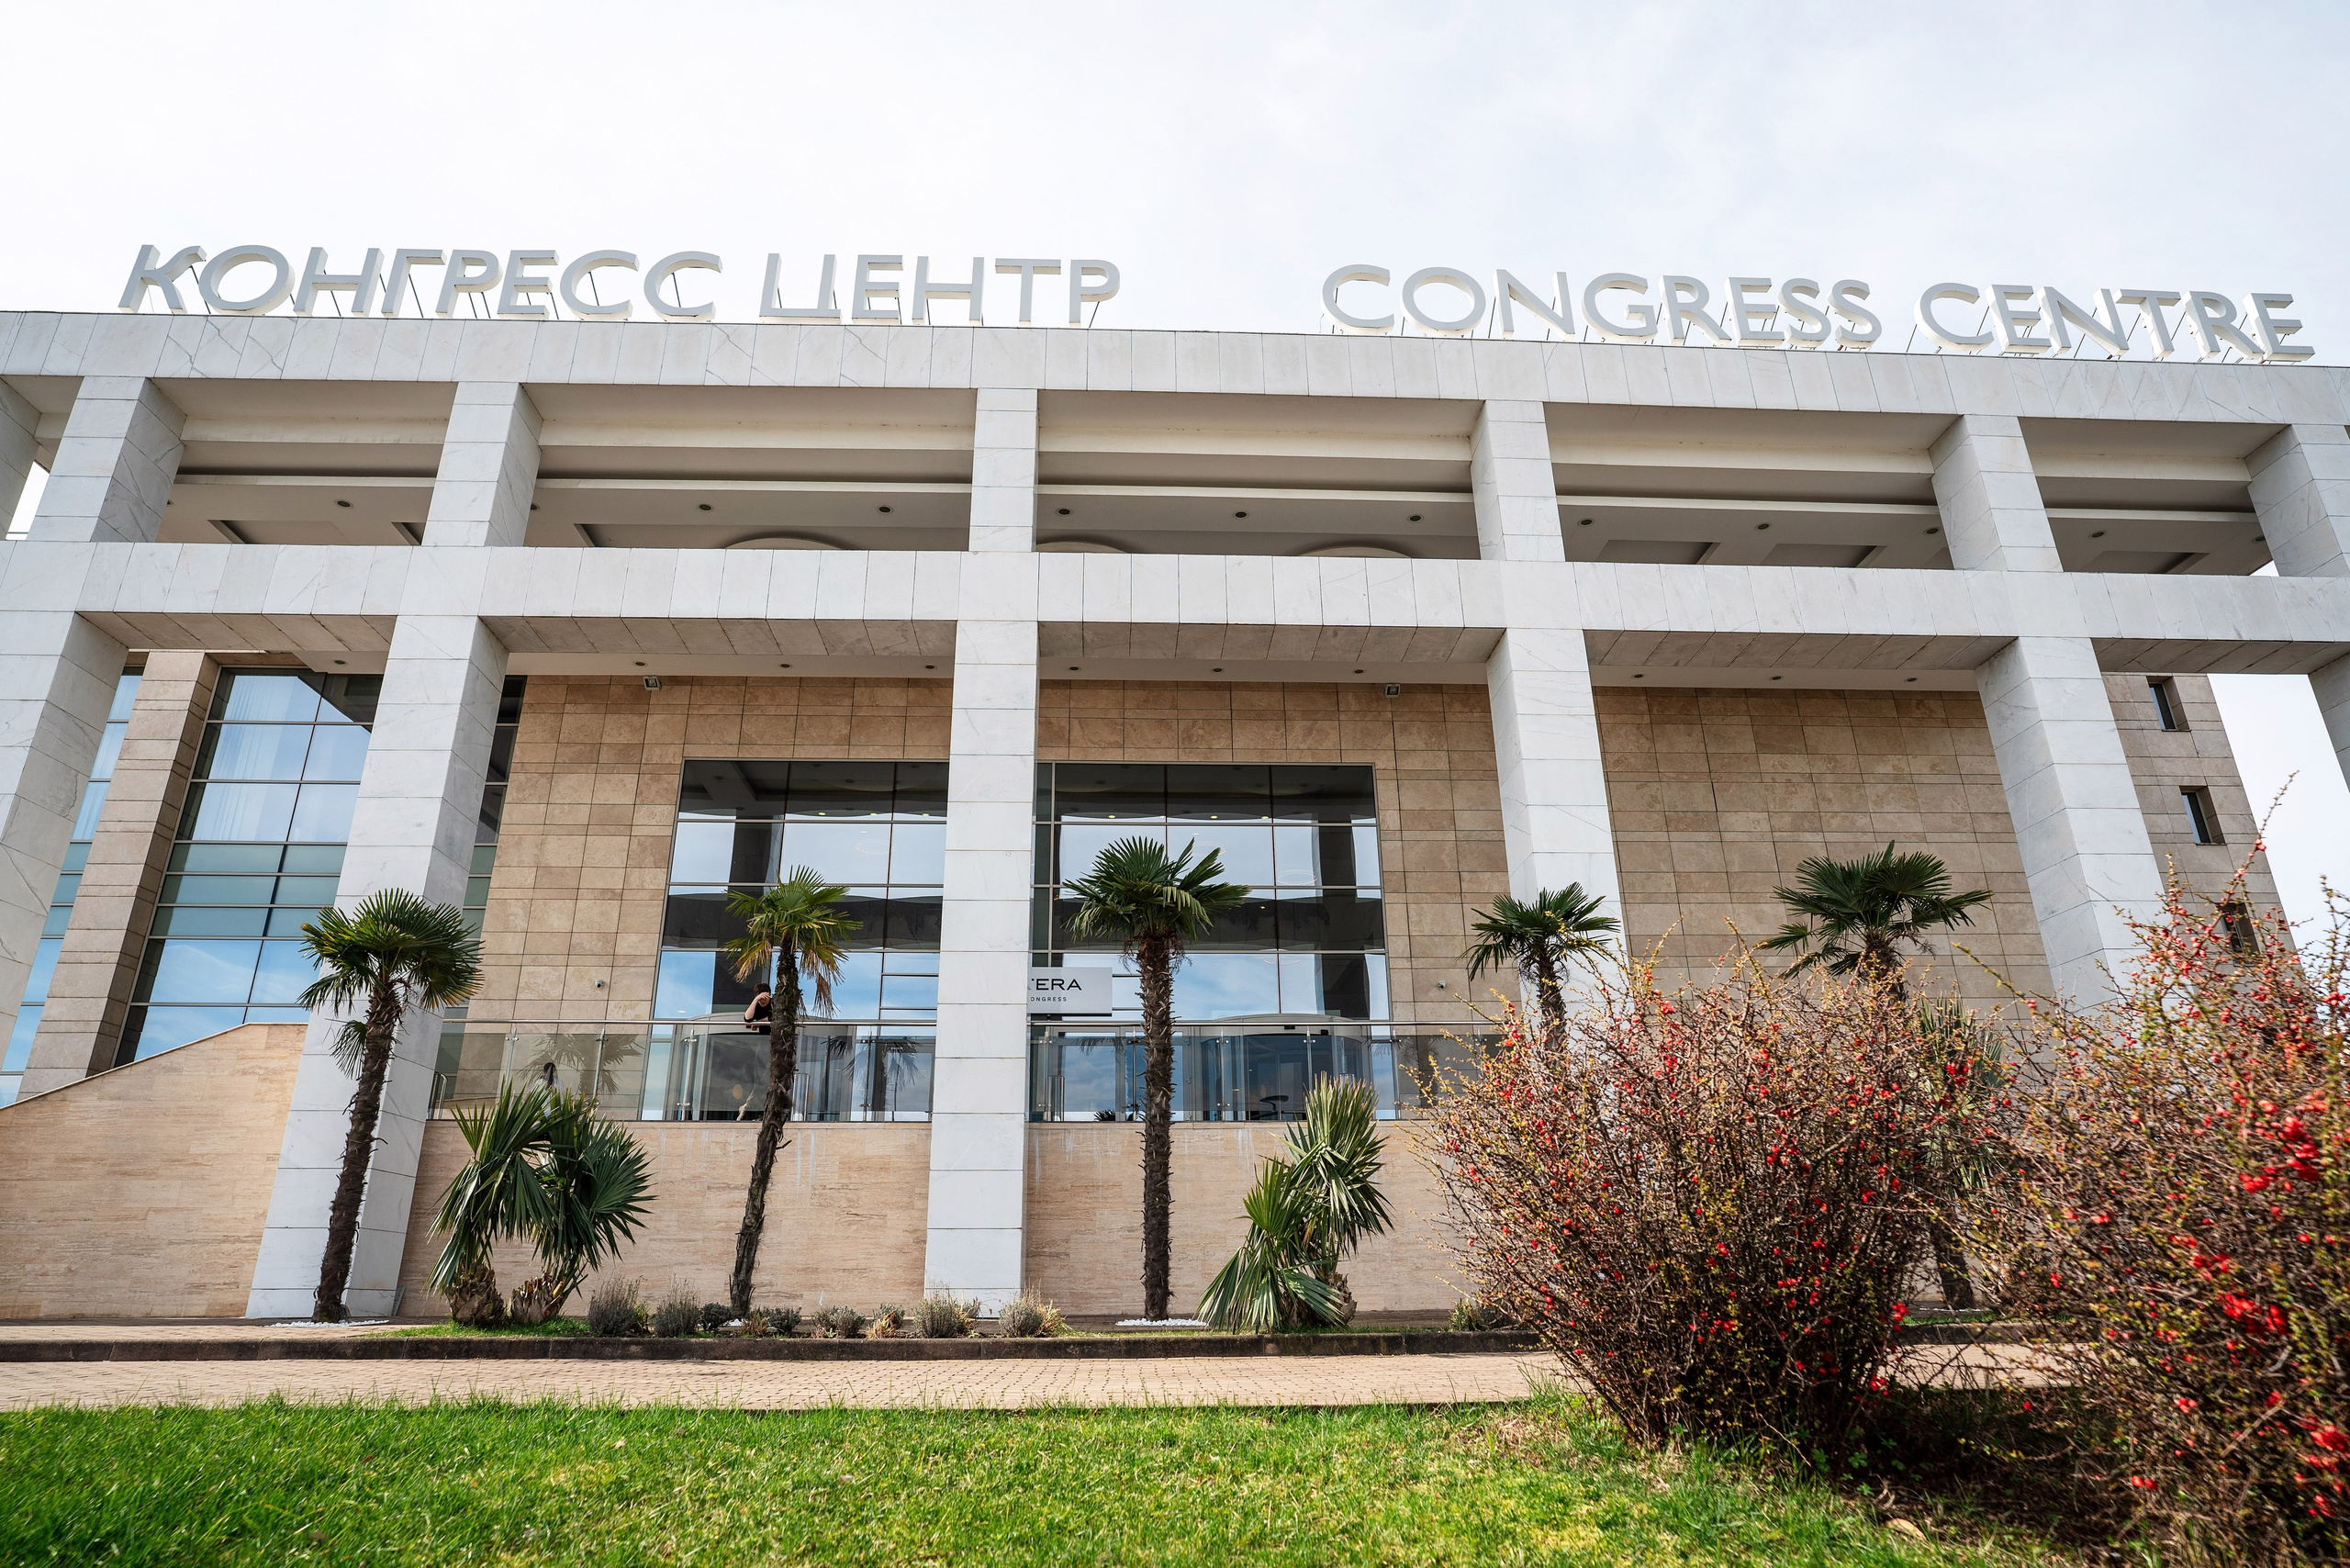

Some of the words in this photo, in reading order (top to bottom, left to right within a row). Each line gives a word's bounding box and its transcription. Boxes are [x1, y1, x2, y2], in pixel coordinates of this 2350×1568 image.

[118, 243, 722, 322] КОНГРЕСС
[759, 252, 1120, 328] ЦЕНТР
[1322, 263, 1883, 349] CONGRESS
[1914, 282, 2316, 363] CENTRE
[1031, 978, 1082, 991] ERA
